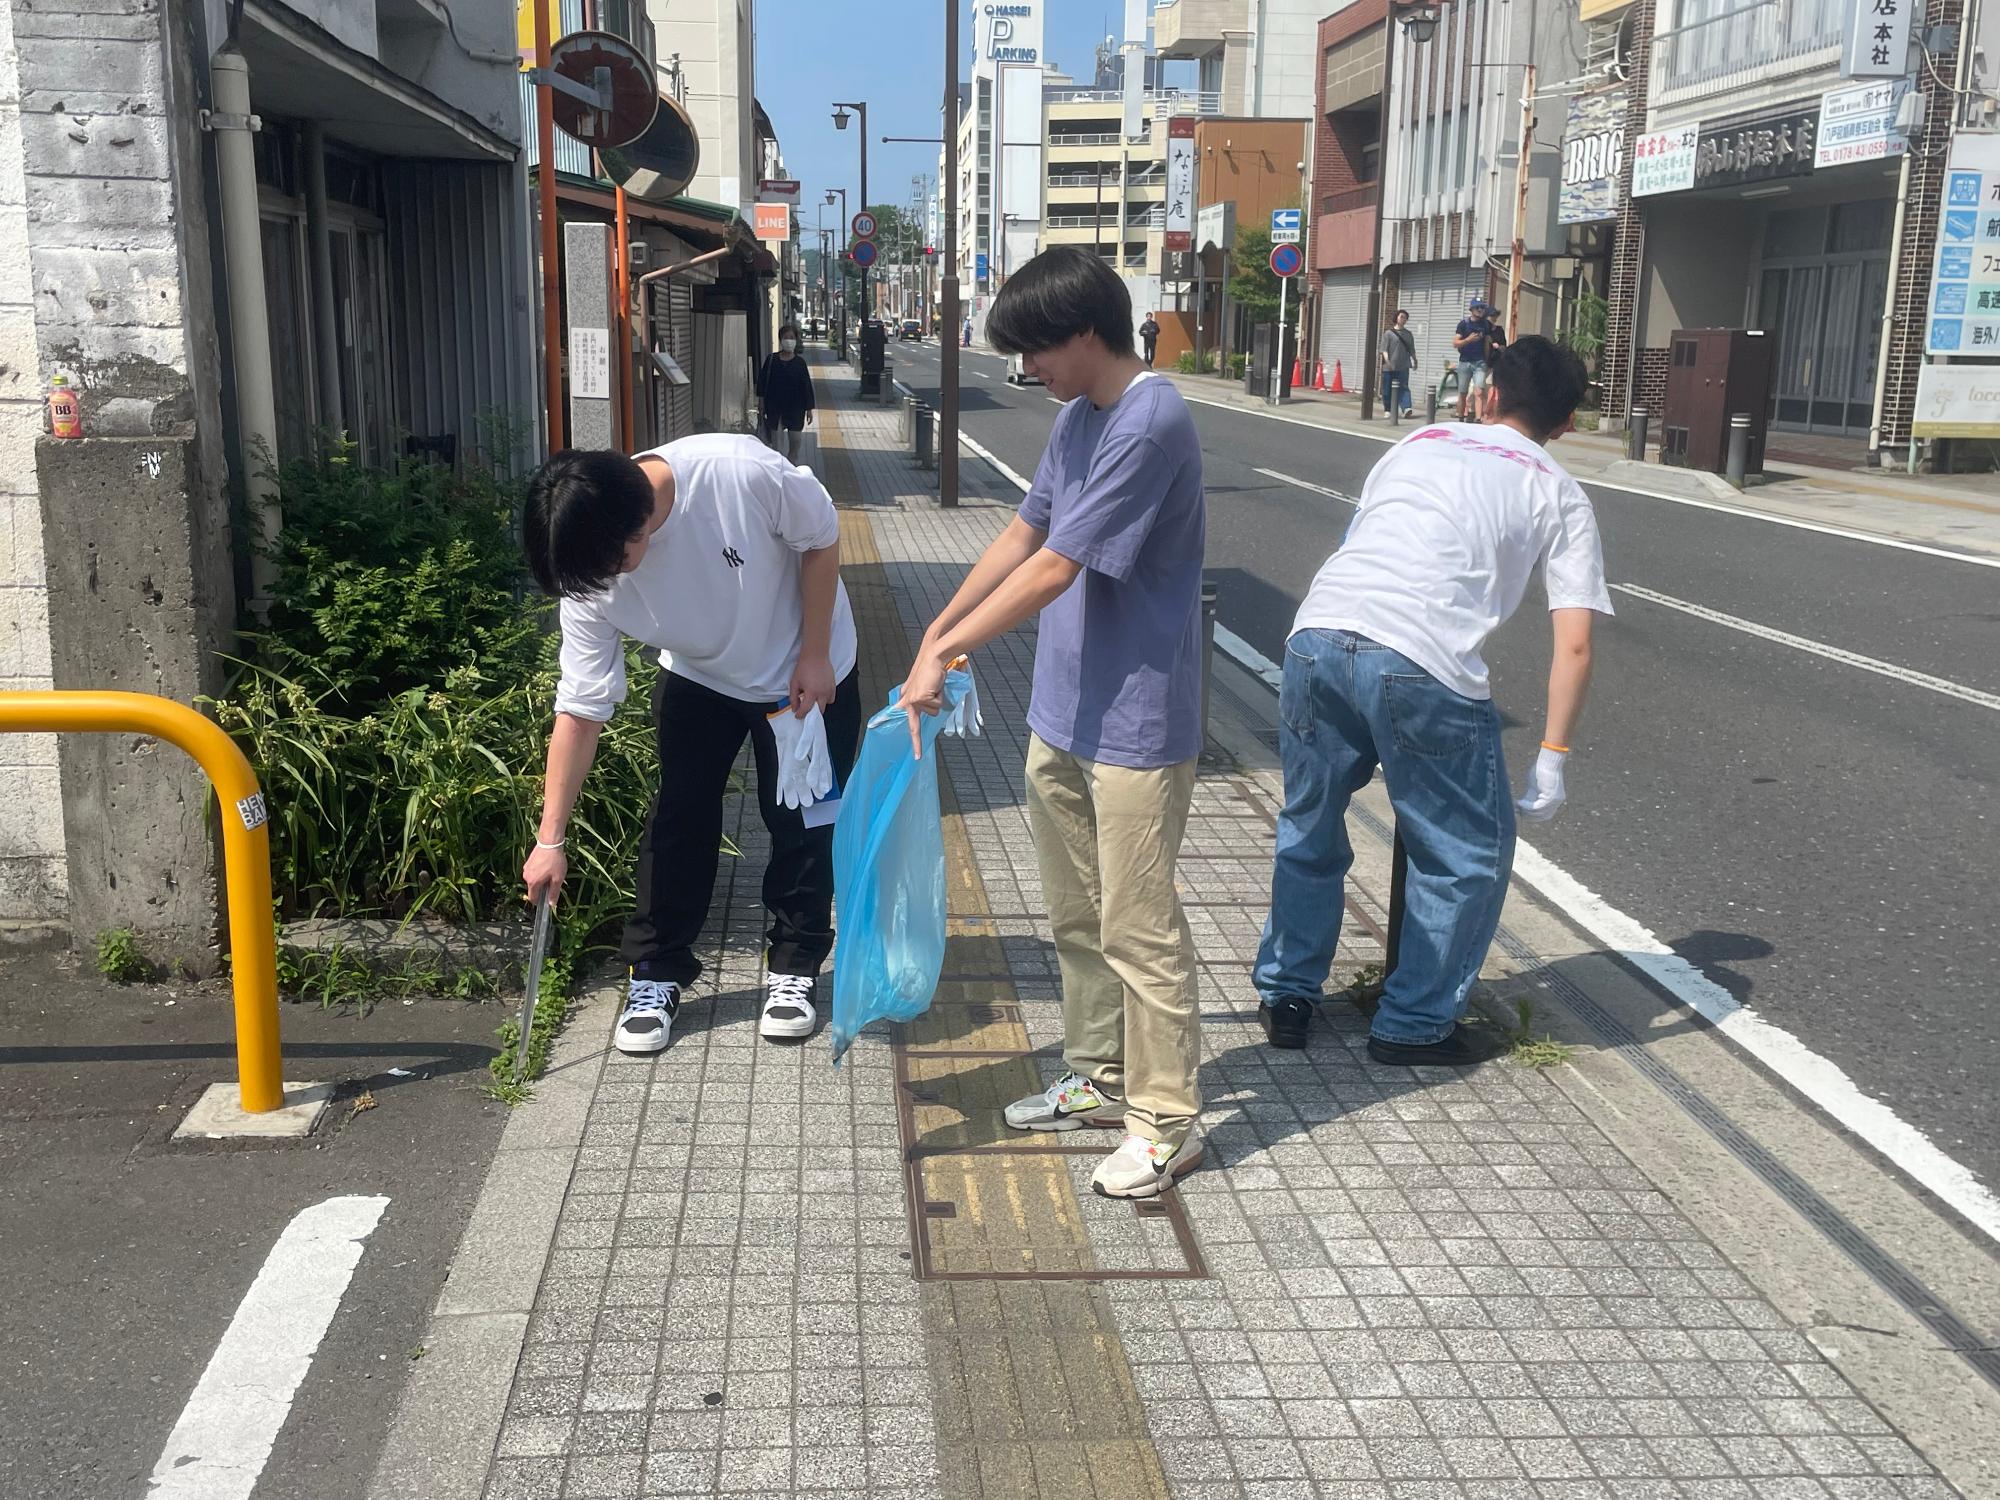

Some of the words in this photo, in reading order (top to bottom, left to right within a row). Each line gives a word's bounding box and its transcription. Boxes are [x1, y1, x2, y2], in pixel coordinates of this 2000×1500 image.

[995, 5, 1031, 17] HASSEI
[987, 16, 1037, 59] PARKING
[757, 217, 785, 229] LINE
[857, 220, 872, 232] 40
[55, 405, 71, 416] BB
